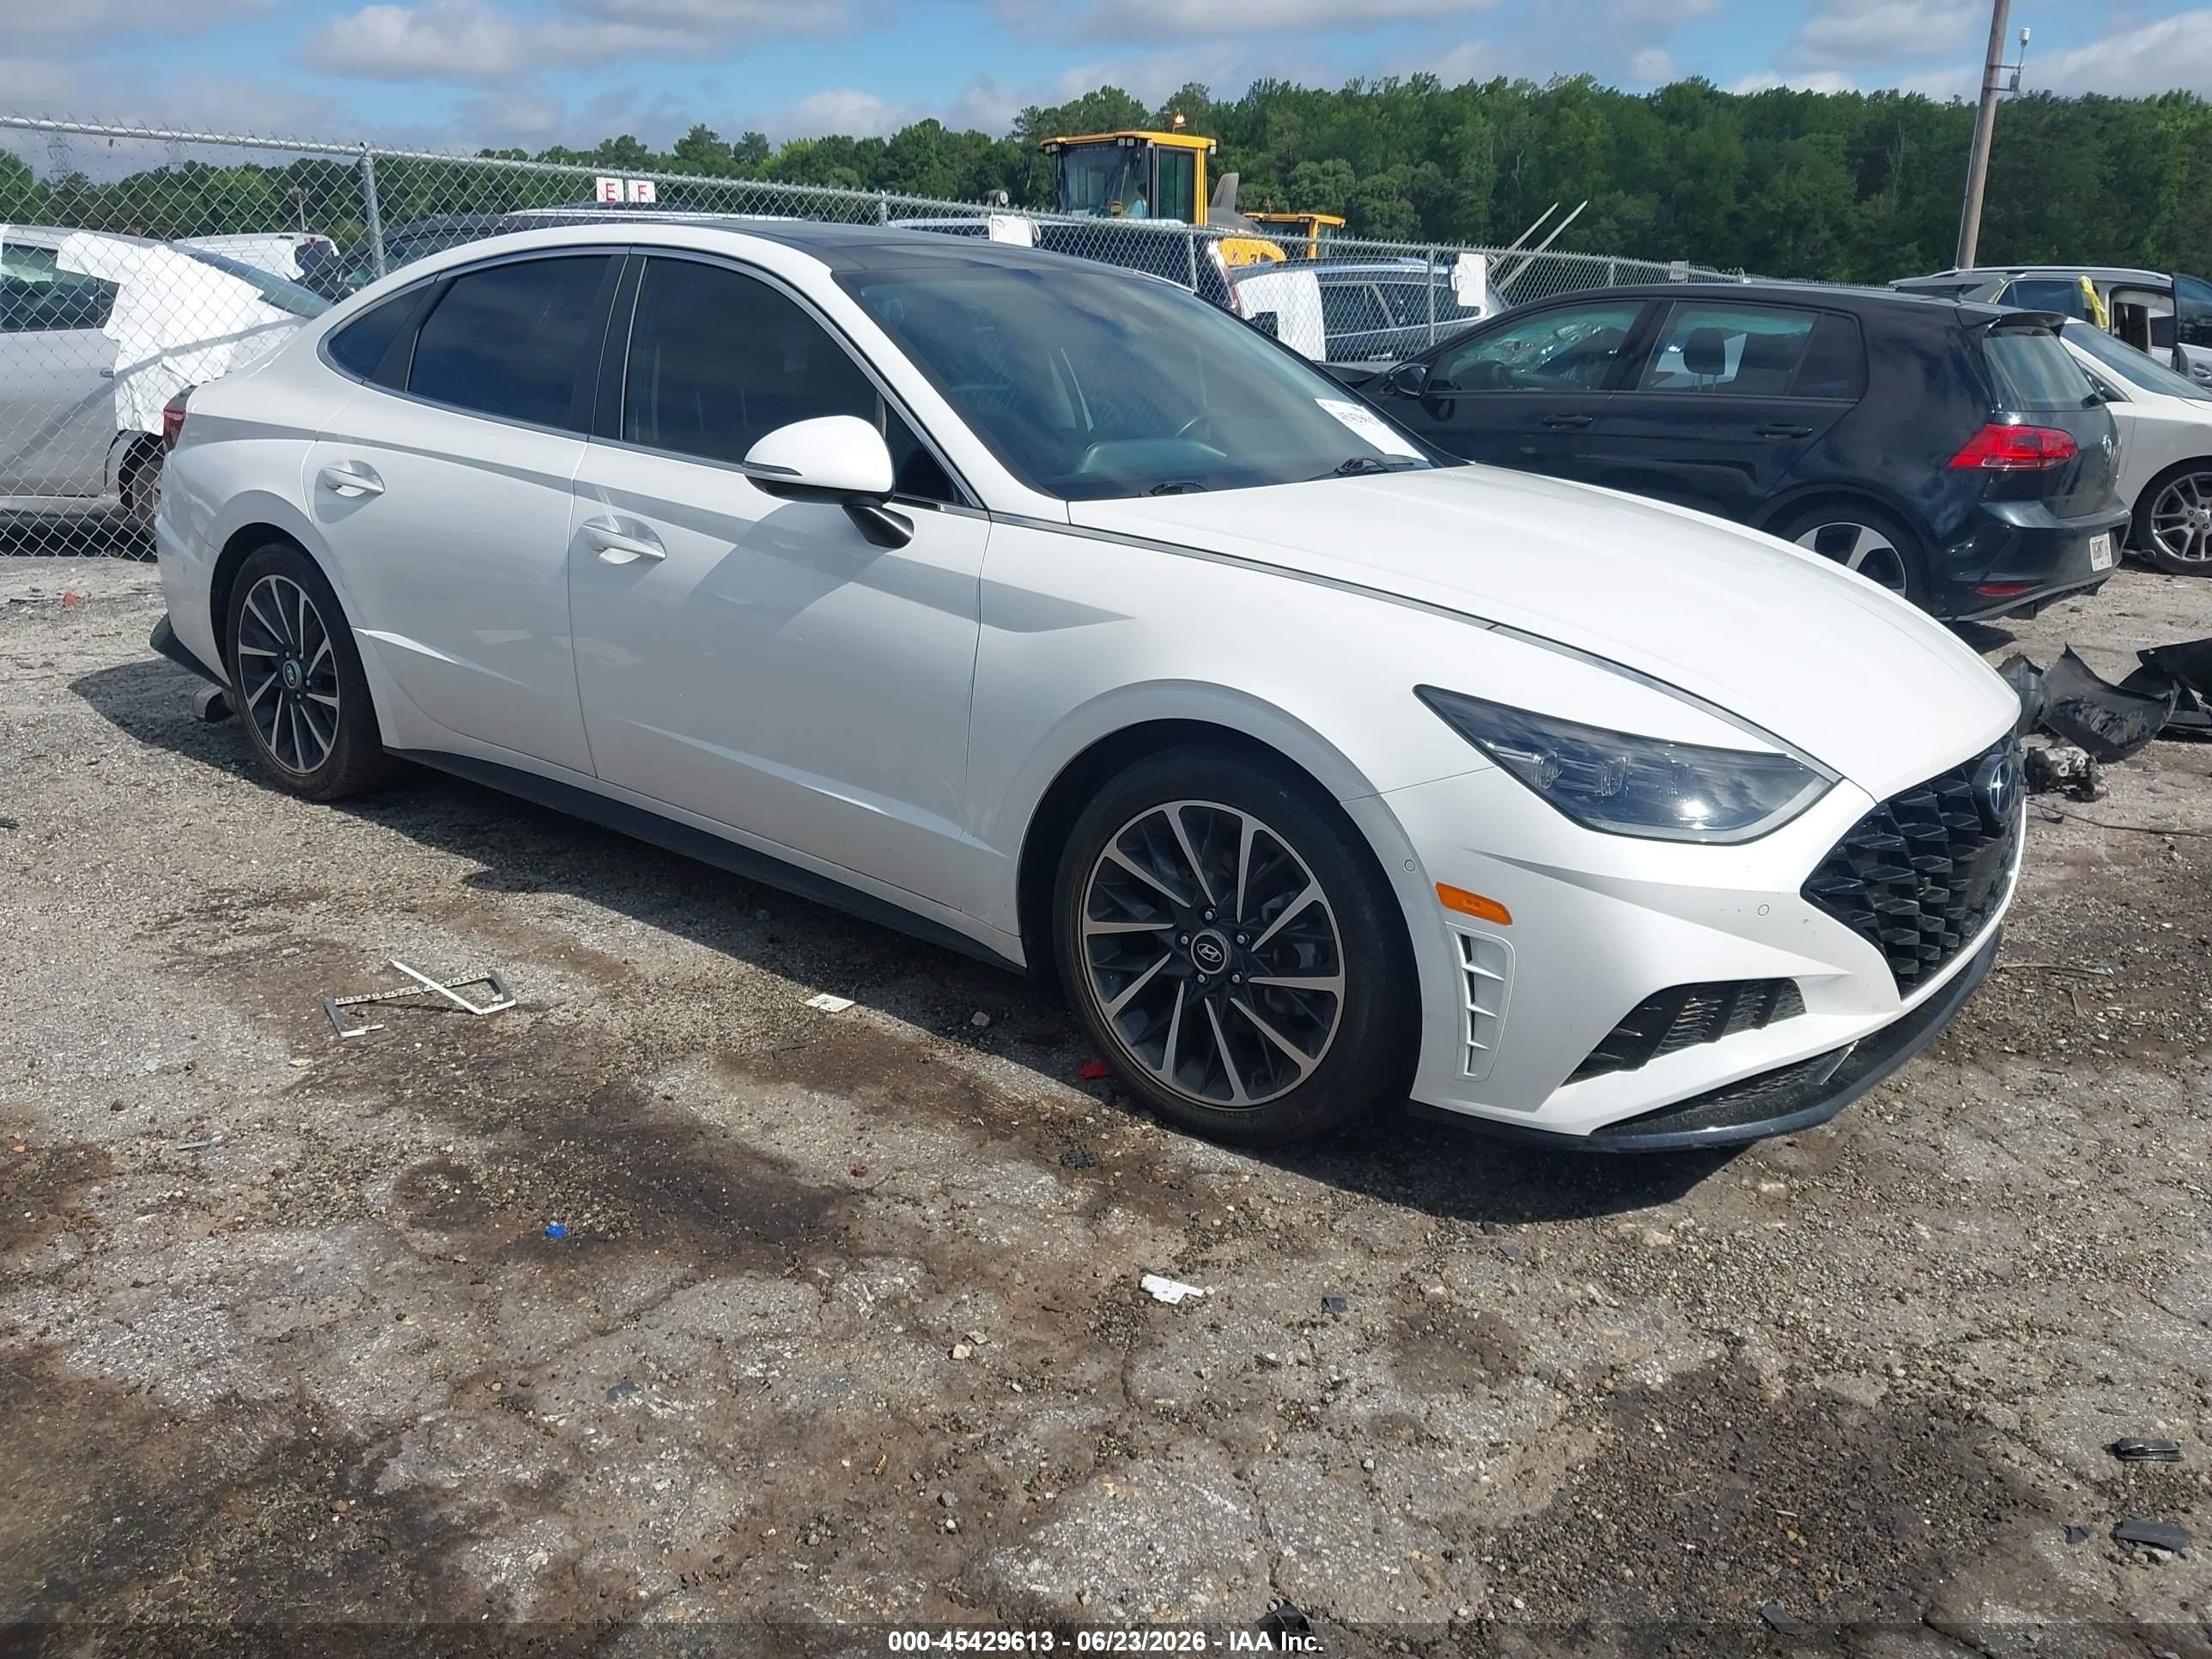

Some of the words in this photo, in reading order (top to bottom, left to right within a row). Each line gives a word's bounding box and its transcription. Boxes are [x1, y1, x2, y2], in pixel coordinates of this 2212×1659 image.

[605, 183, 616, 201] E
[637, 185, 647, 202] F
[334, 993, 381, 1005] BEACH
